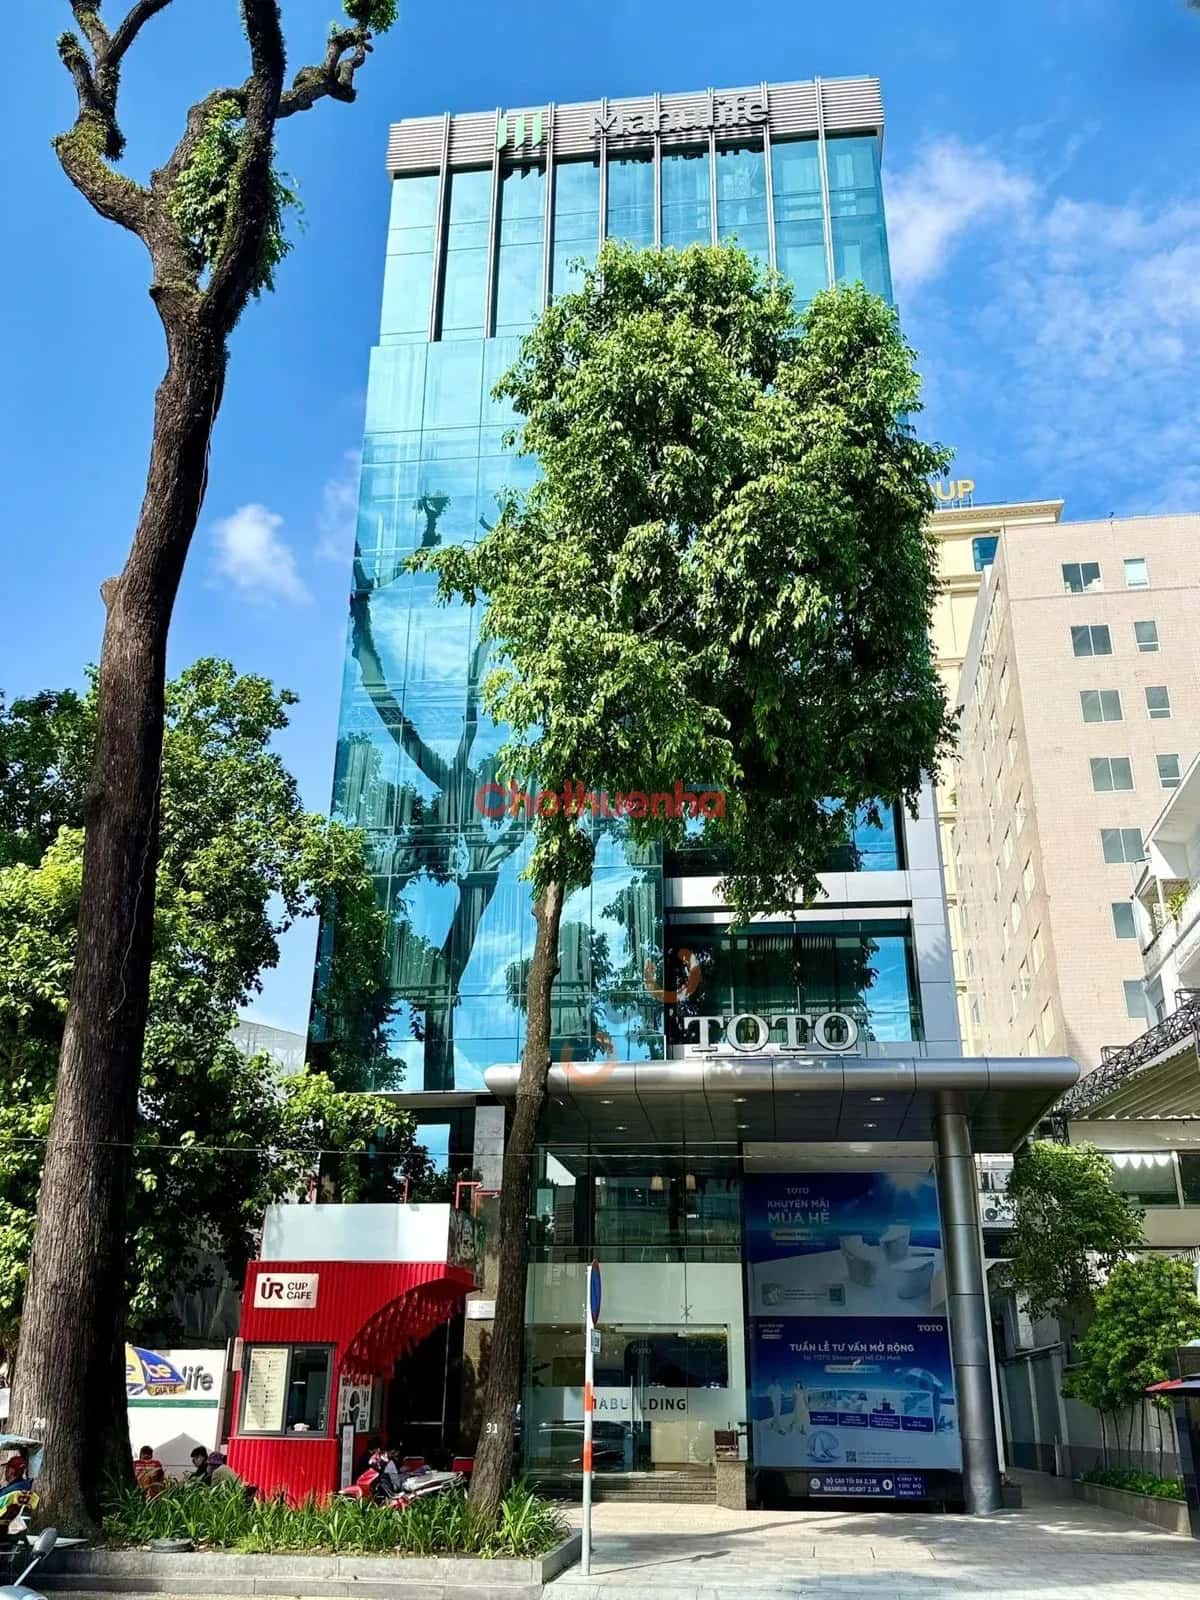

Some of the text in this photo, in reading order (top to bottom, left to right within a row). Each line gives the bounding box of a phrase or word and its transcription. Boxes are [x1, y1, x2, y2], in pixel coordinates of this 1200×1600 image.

[588, 96, 769, 138] Manulife
[684, 1012, 859, 1053] TOTO
[287, 1282, 309, 1291] CUP
[286, 1291, 312, 1300] CAFE
[917, 1324, 944, 1332] TOTO
[141, 1360, 171, 1378] be
[486, 1422, 498, 1434] 31
